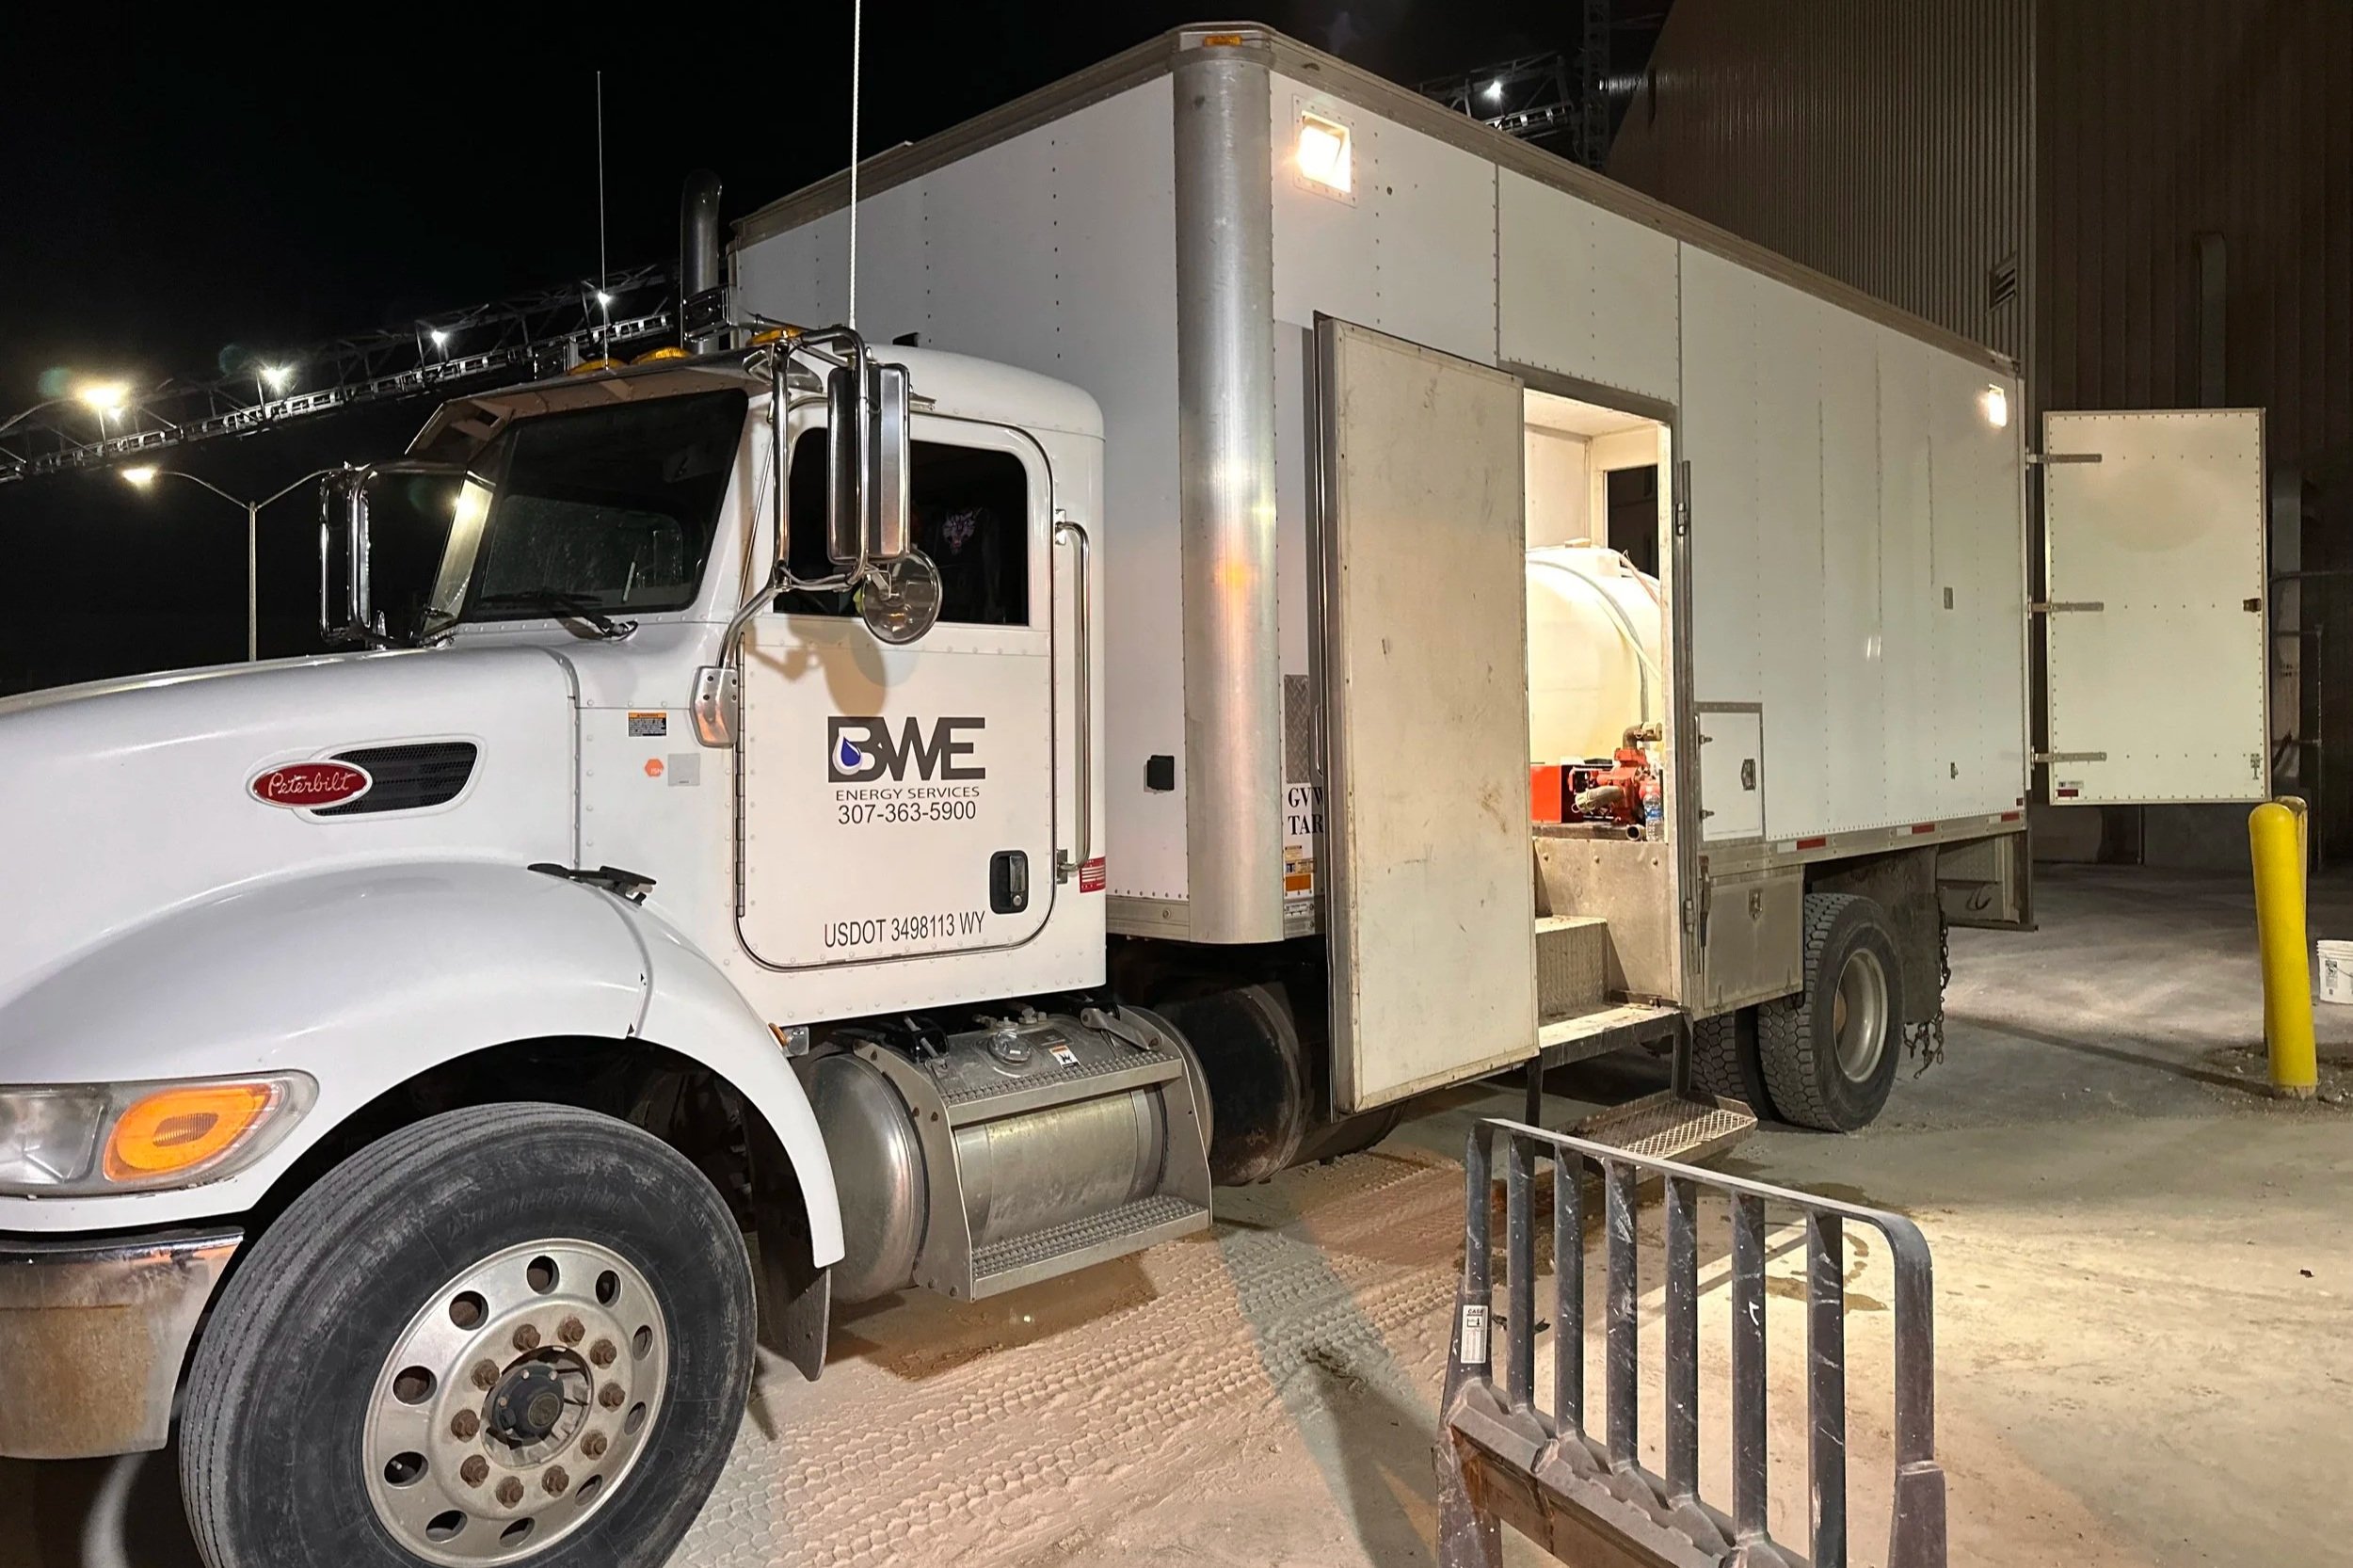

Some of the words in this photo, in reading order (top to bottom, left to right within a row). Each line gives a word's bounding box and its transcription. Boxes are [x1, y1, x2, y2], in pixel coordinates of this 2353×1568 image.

[828, 716, 985, 783] BWE
[268, 772, 357, 797] Peterbilt
[836, 789, 904, 802] ENERGY
[908, 786, 980, 799] SERVICES
[838, 800, 976, 824] 307-363-5900
[824, 919, 887, 948] USDOT
[891, 913, 954, 941] 3498113
[959, 910, 985, 935] WY
